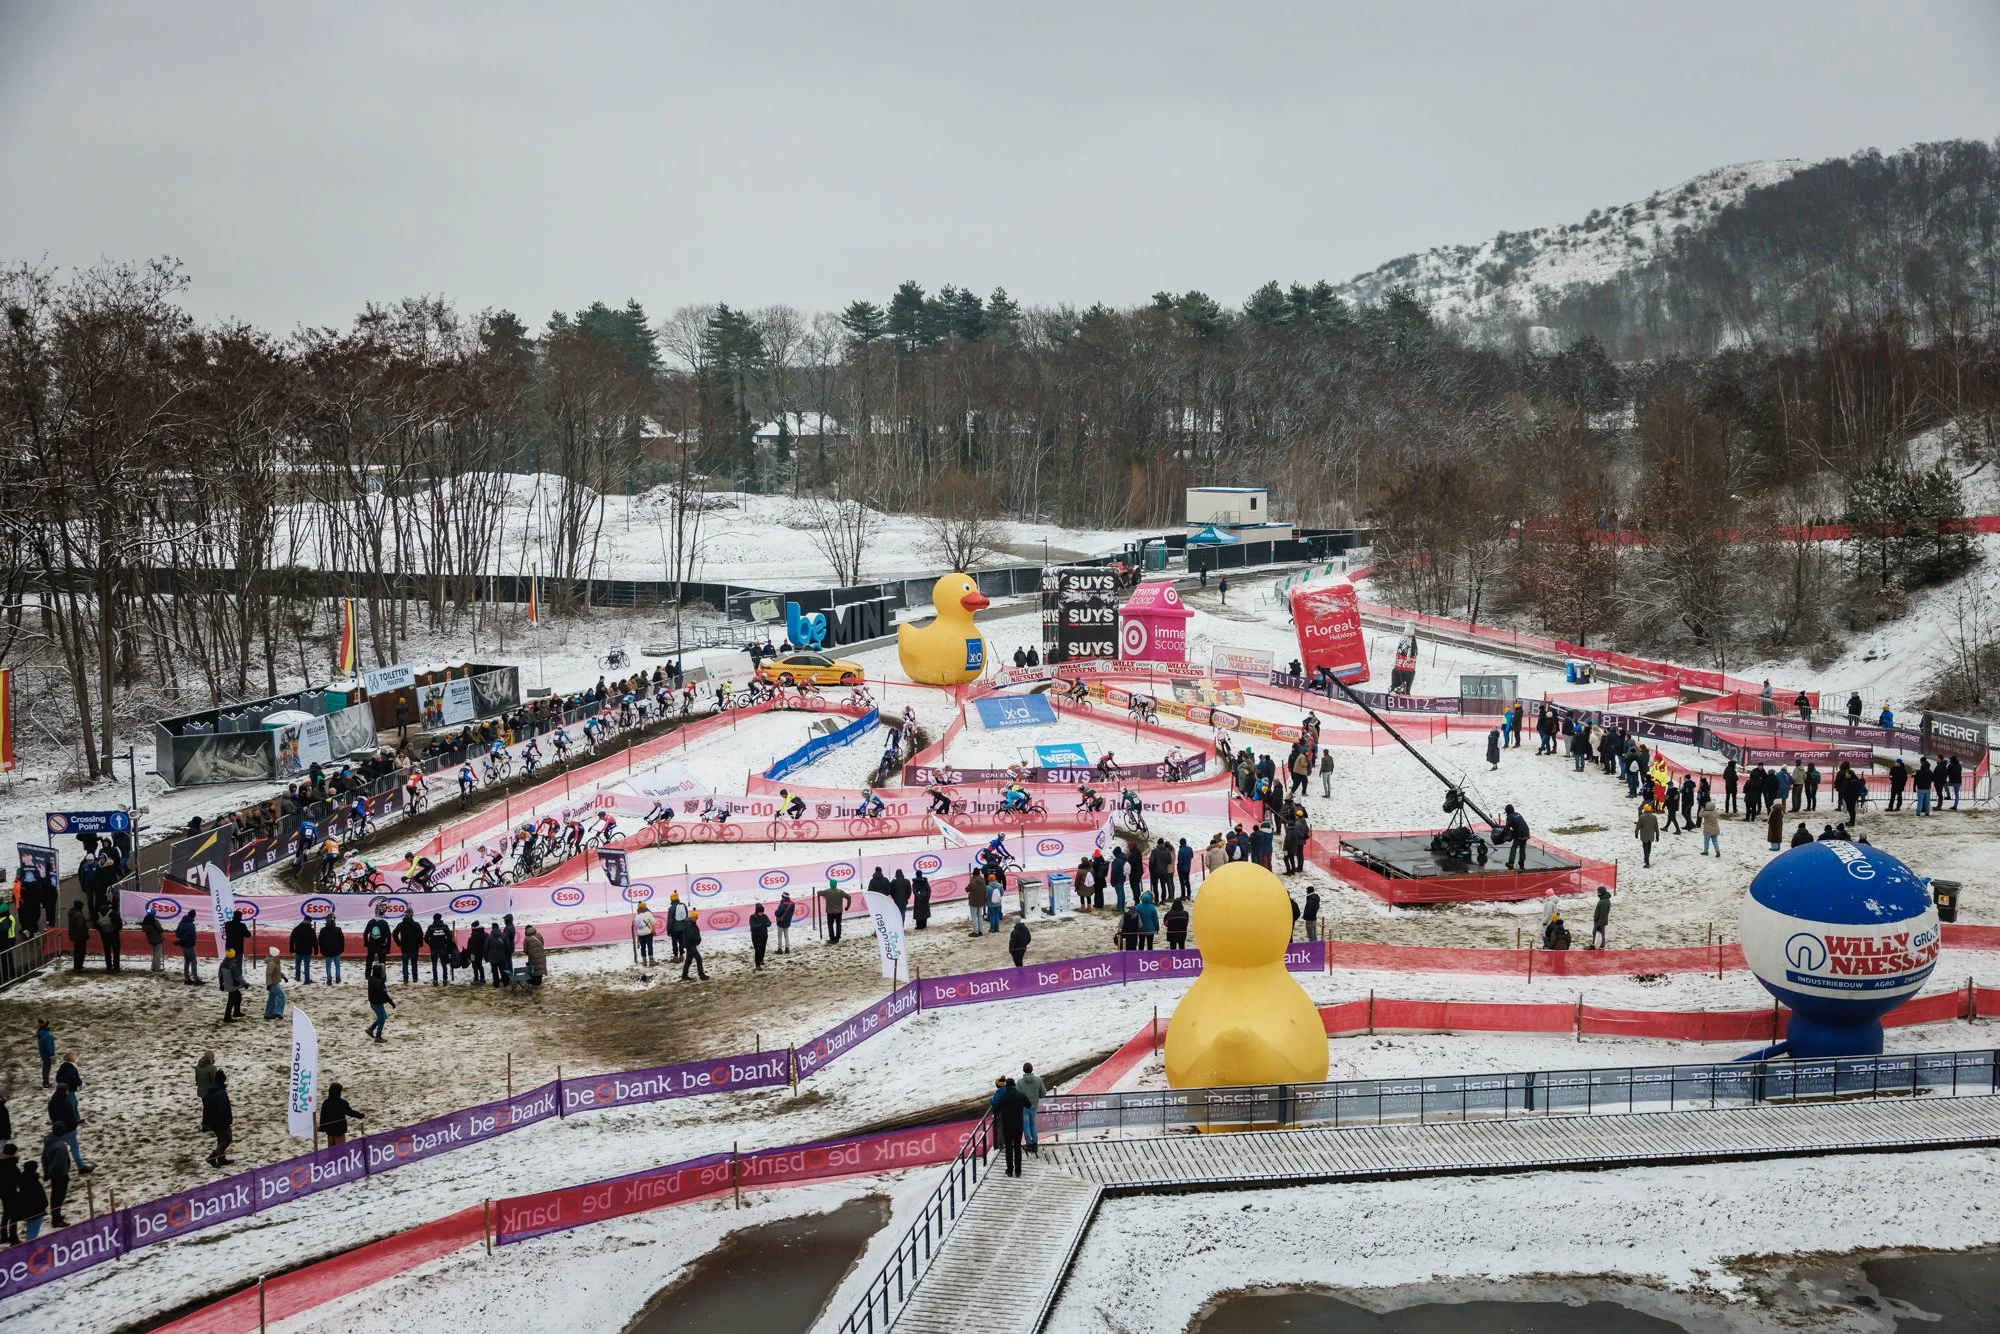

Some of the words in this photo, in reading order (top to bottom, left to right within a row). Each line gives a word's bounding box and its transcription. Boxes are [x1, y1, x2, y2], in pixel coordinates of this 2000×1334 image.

[1070, 576, 1114, 589] SUYS
[1134, 586, 1160, 597] immo
[1069, 609, 1114, 622] SUYS
[1154, 624, 1185, 638] immo
[1305, 619, 1354, 638] Floreal
[1329, 632, 1356, 640] Holidays
[1068, 642, 1113, 655] SUYS
[1154, 640, 1185, 653] scoop
[1228, 655, 1254, 663] WILLY
[1009, 668, 1029, 677] WILLY
[1060, 662, 1081, 670] WILLY
[1228, 662, 1270, 672] NAESSENS
[379, 668, 408, 681] TOILETTEN
[1010, 672, 1044, 683] NAESSENS
[1271, 673, 1305, 689] BLITZ
[1462, 685, 1497, 694] BLITZ
[1388, 697, 1430, 709] BLITZ
[1000, 718, 1040, 726] BADKAMERS
[1602, 715, 1655, 735] BLITZ
[1704, 715, 1732, 724] PIERRET
[1739, 718, 1768, 727] PIERRET
[1776, 722, 1806, 731] PIERRET
[1816, 726, 1847, 735] PIERRET
[1931, 720, 1979, 742] PIERRET
[1855, 730, 1887, 738] PIERRET
[1894, 731, 1920, 742] PIERRET
[1041, 753, 1085, 763] WEBA
[1838, 751, 1873, 759] PIERRET
[916, 769, 963, 782] SYS
[1047, 770, 1090, 784] SUYS
[656, 785, 681, 797] Jupiler
[384, 802, 392, 814] EY
[572, 800, 594, 818] Jupiler
[705, 801, 749, 813] Jiler
[1110, 799, 1160, 812] Juler
[70, 815, 106, 825] Crossing
[328, 824, 337, 837] EY
[288, 840, 297, 854] EY
[267, 849, 276, 862] EY
[243, 858, 255, 873] EY
[918, 860, 938, 869] Esso
[186, 861, 210, 887] EY
[831, 868, 851, 877] Esso
[696, 883, 718, 891] Esso
[764, 876, 785, 885] Esso
[556, 892, 579, 900] Esso
[627, 889, 649, 898] Esso
[152, 904, 177, 913] Esso
[306, 904, 329, 913] Esso
[454, 900, 477, 908] Esso
[238, 907, 255, 915] sso
[1824, 932, 1910, 956] WILLY
[1913, 924, 1938, 947] GROP
[1830, 938, 1940, 975] NAESSENS
[1139, 955, 1200, 973] beoban
[1037, 963, 1112, 986] beobank
[1798, 976, 1863, 989] INDUSTRIEBOUW
[1874, 980, 1895, 988] AGRO
[935, 978, 1010, 1001] beobank
[862, 988, 917, 1033] beobank
[799, 1023, 858, 1072] beobank
[682, 1058, 784, 1090] beobank
[564, 1075, 671, 1109] beobank
[470, 1092, 554, 1137] beobank
[369, 1122, 462, 1166] beobank
[261, 1148, 363, 1201] beobank
[133, 1185, 250, 1238] beobank
